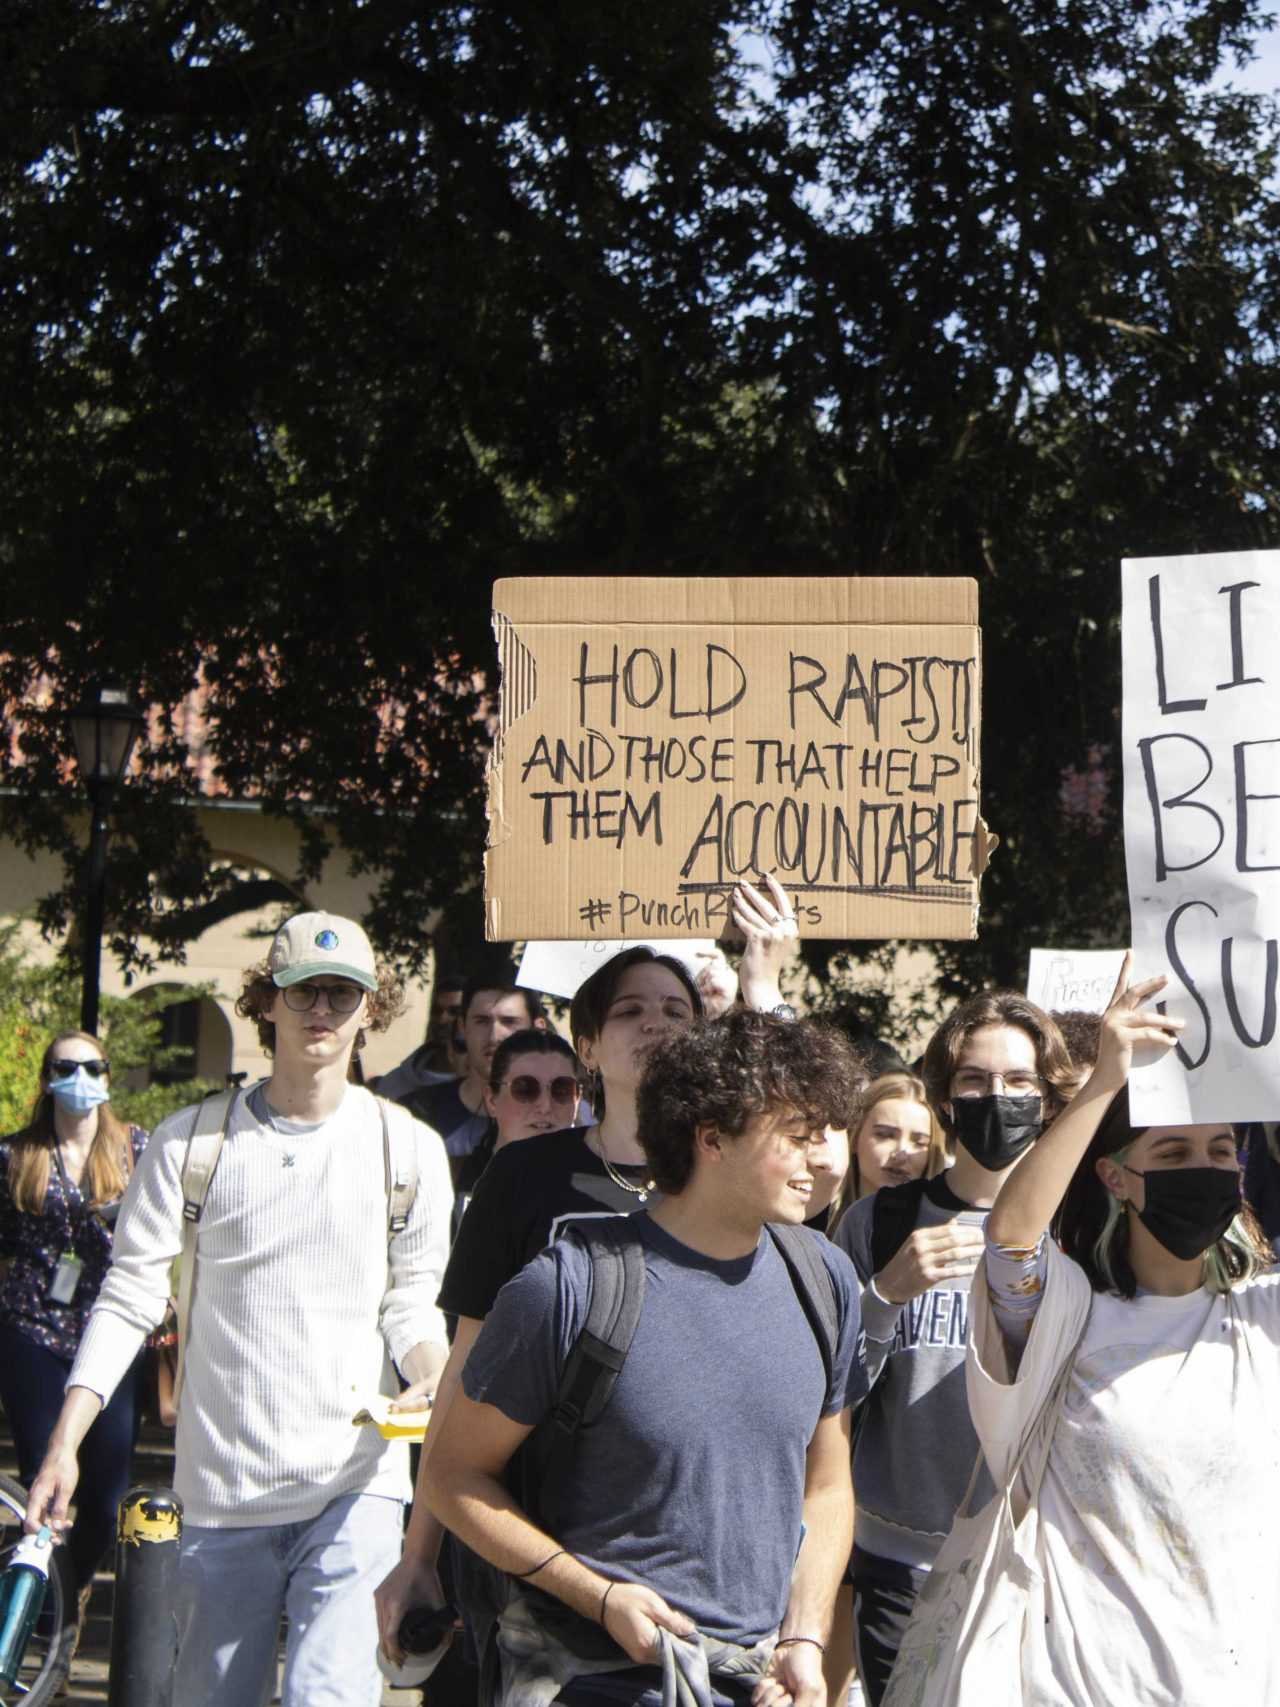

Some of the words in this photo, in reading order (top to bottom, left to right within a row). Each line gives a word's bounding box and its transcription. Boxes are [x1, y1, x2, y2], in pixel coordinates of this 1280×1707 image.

[572, 641, 747, 727] HOLD
[521, 728, 615, 785] AND
[618, 735, 735, 784] THOSE
[746, 740, 854, 793] THAT
[859, 748, 961, 797] HELP
[530, 789, 663, 850] THEM
[678, 794, 977, 891] ACCOUNTABLE
[578, 889, 823, 934] #PunchRts
